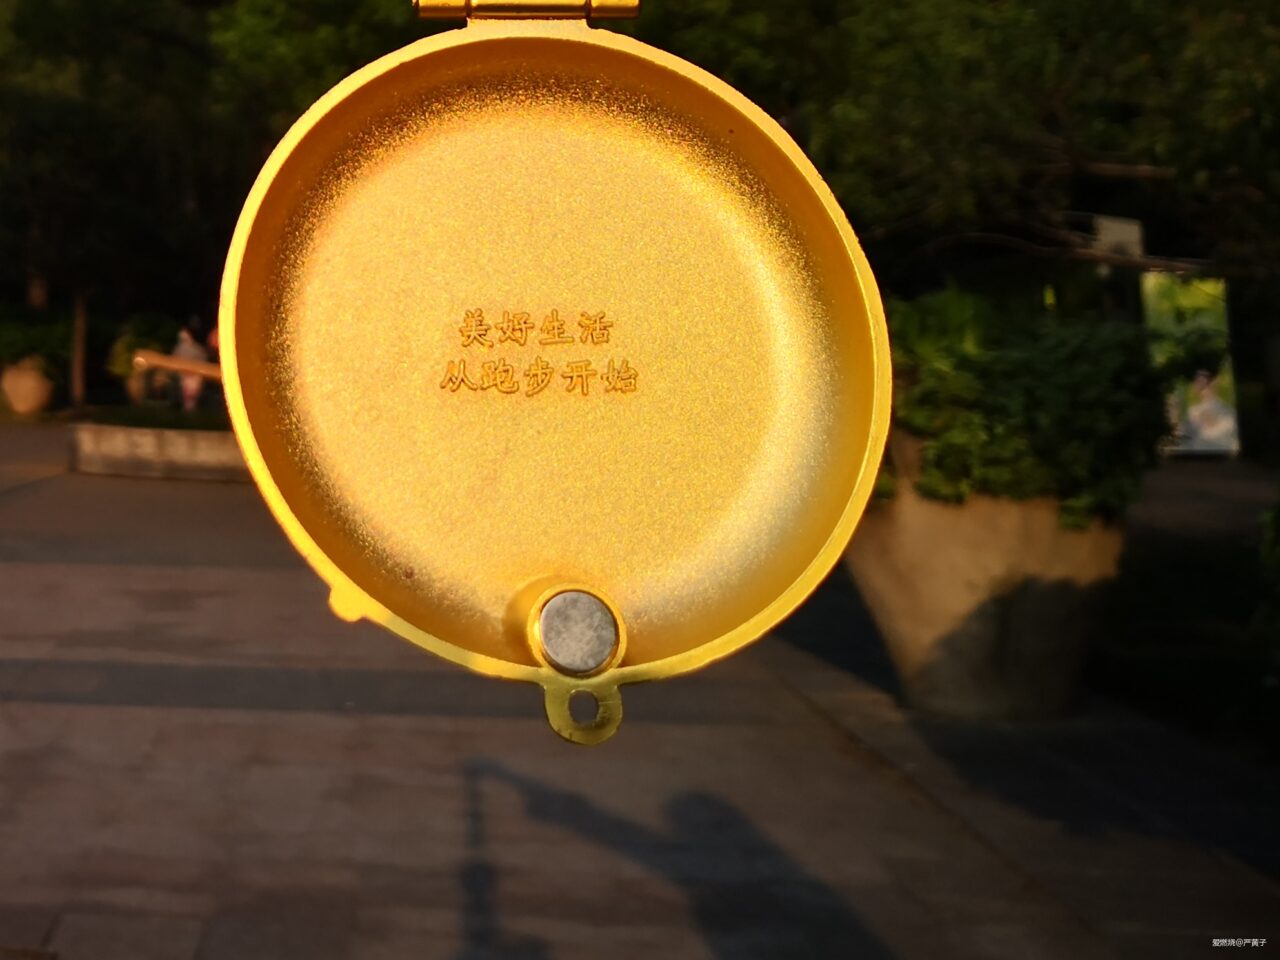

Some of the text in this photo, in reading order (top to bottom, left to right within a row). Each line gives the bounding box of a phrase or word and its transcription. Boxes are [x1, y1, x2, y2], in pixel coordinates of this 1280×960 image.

[459, 308, 614, 348] 美好生活
[439, 356, 639, 397] 从跑步开始
